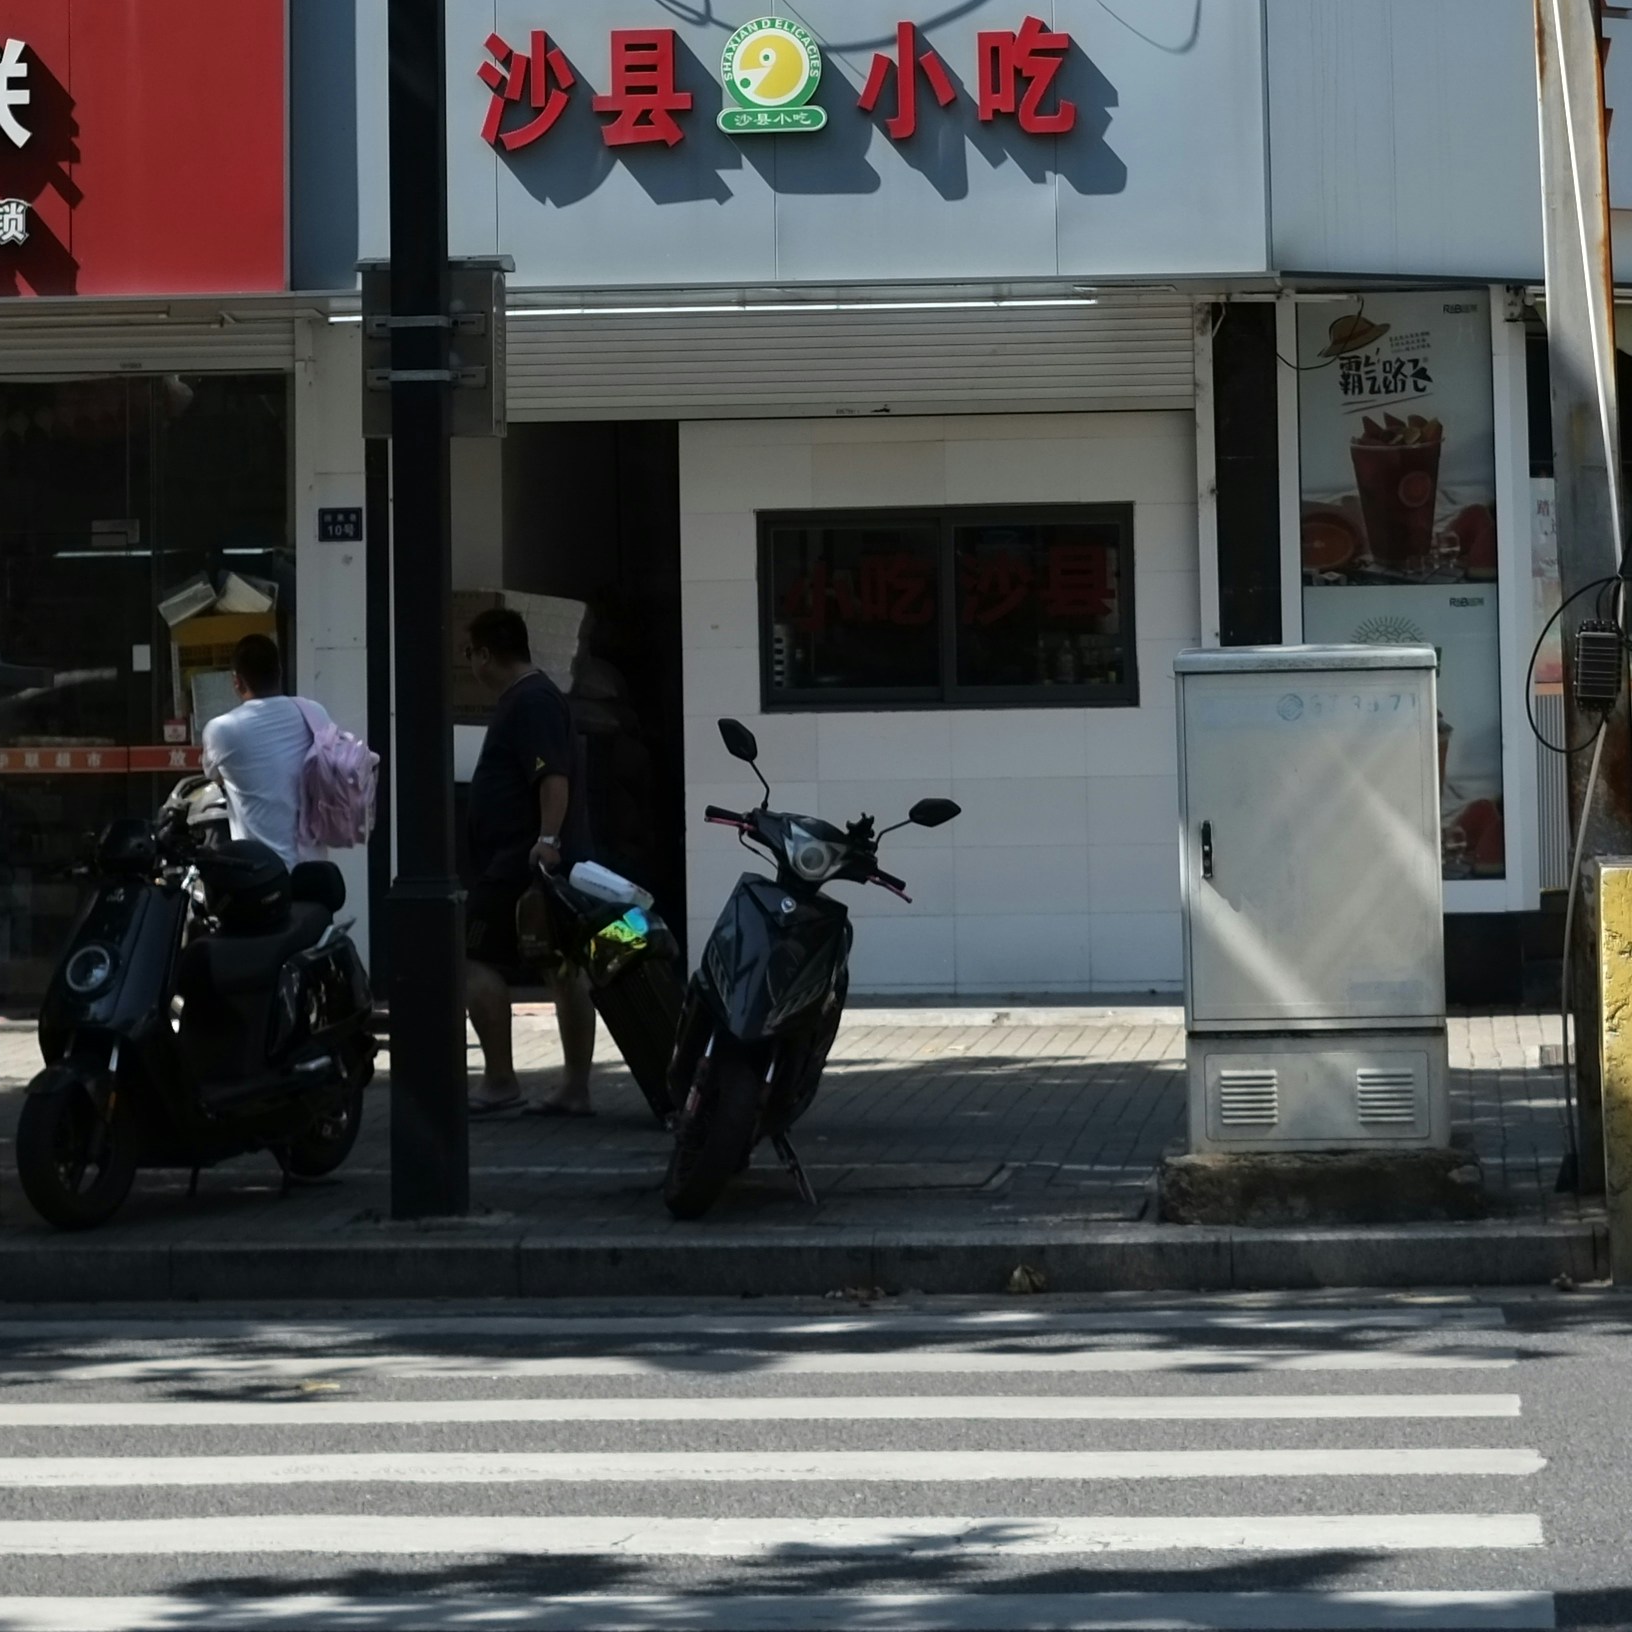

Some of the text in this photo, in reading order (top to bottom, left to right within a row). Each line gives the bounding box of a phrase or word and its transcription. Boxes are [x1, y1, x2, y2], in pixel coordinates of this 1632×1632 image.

[476, 15, 1078, 151] 沙县 小吃
[723, 22, 759, 81] SHAXIAN
[734, 112, 812, 126] 沙县小吃
[783, 543, 1116, 633] 小吃 沙县
